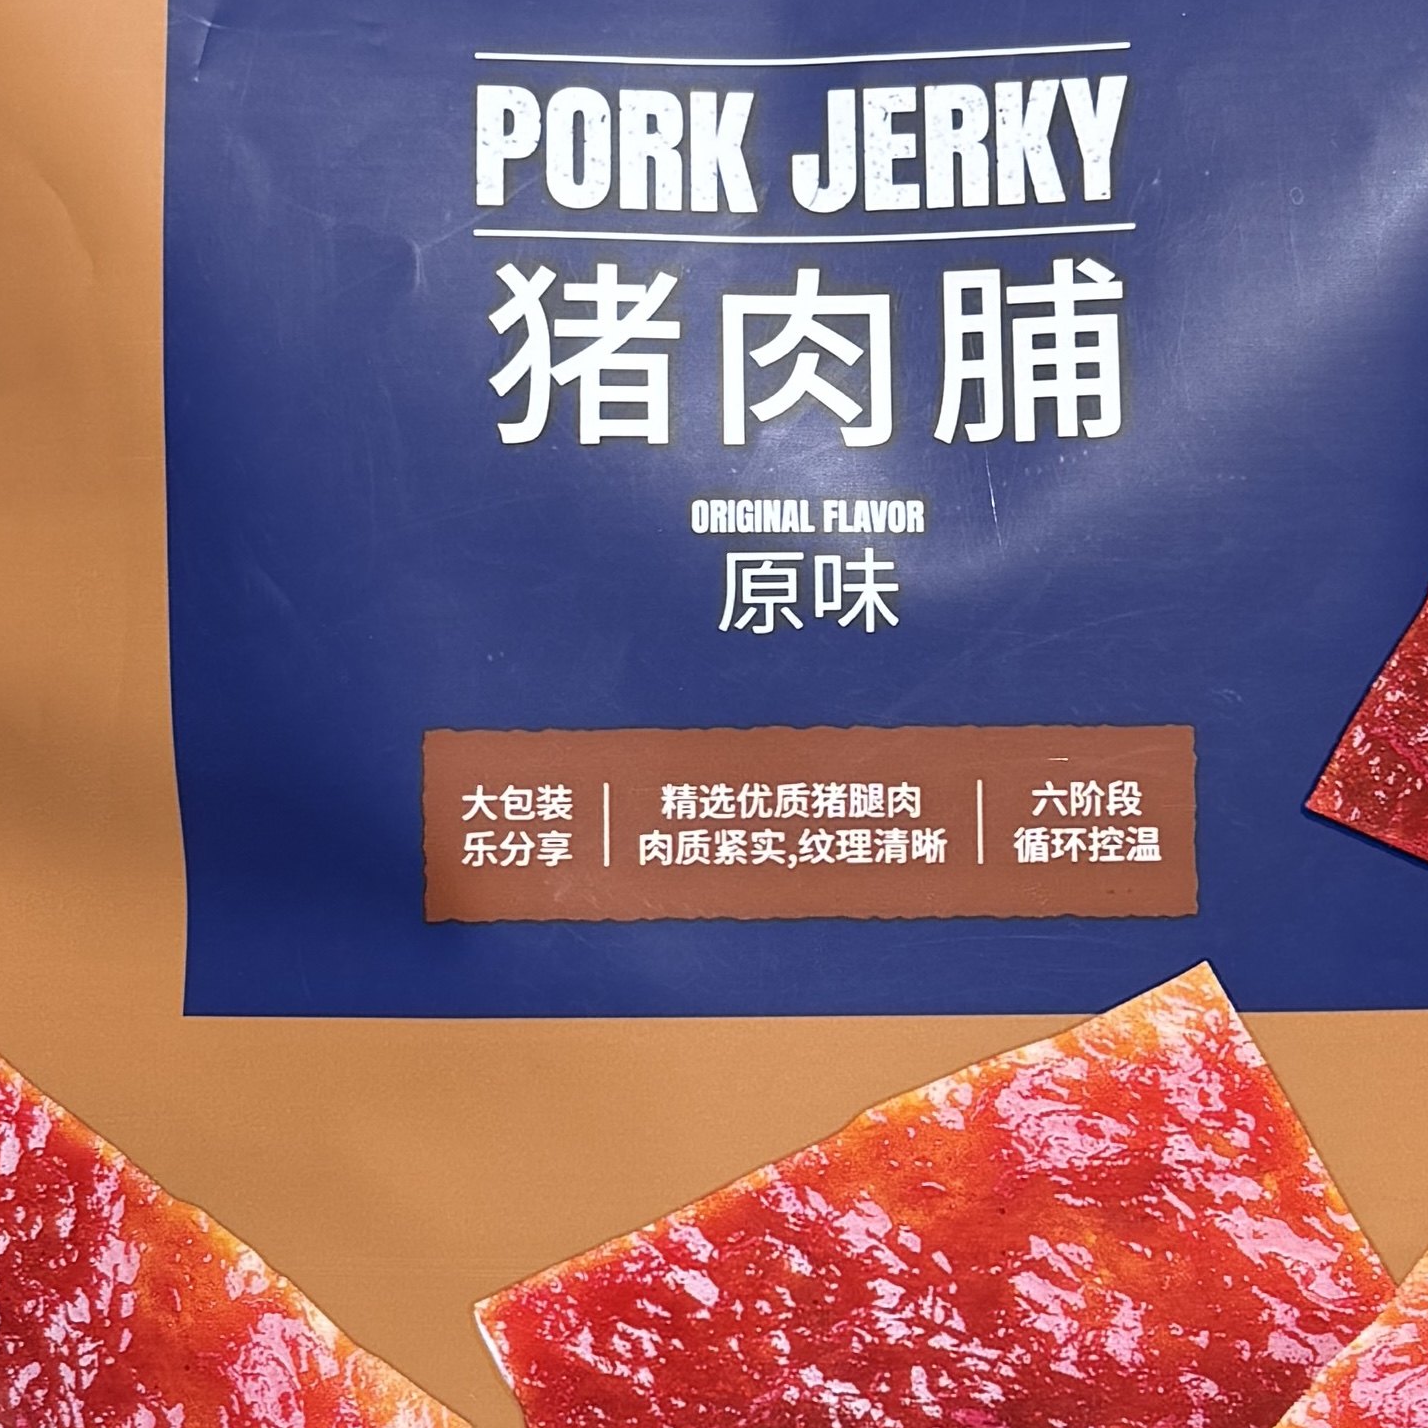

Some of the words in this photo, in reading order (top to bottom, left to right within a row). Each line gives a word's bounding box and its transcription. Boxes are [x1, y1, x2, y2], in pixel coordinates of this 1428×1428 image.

[476, 85, 758, 212] PORK
[792, 76, 1127, 213] JERKY
[489, 258, 1124, 447] 猪肉脯
[692, 499, 815, 533] ORIGINAL
[821, 499, 924, 533] FLAVOR
[719, 547, 898, 633] 原味
[462, 784, 572, 820] 大包装
[661, 782, 920, 819] 精选优质猪腿肉
[1032, 780, 1142, 816] 六阶段
[462, 830, 572, 866] 乐分享
[640, 828, 947, 868] 肉质紧实,纹理清晰
[1014, 826, 1161, 862] 循环控温
